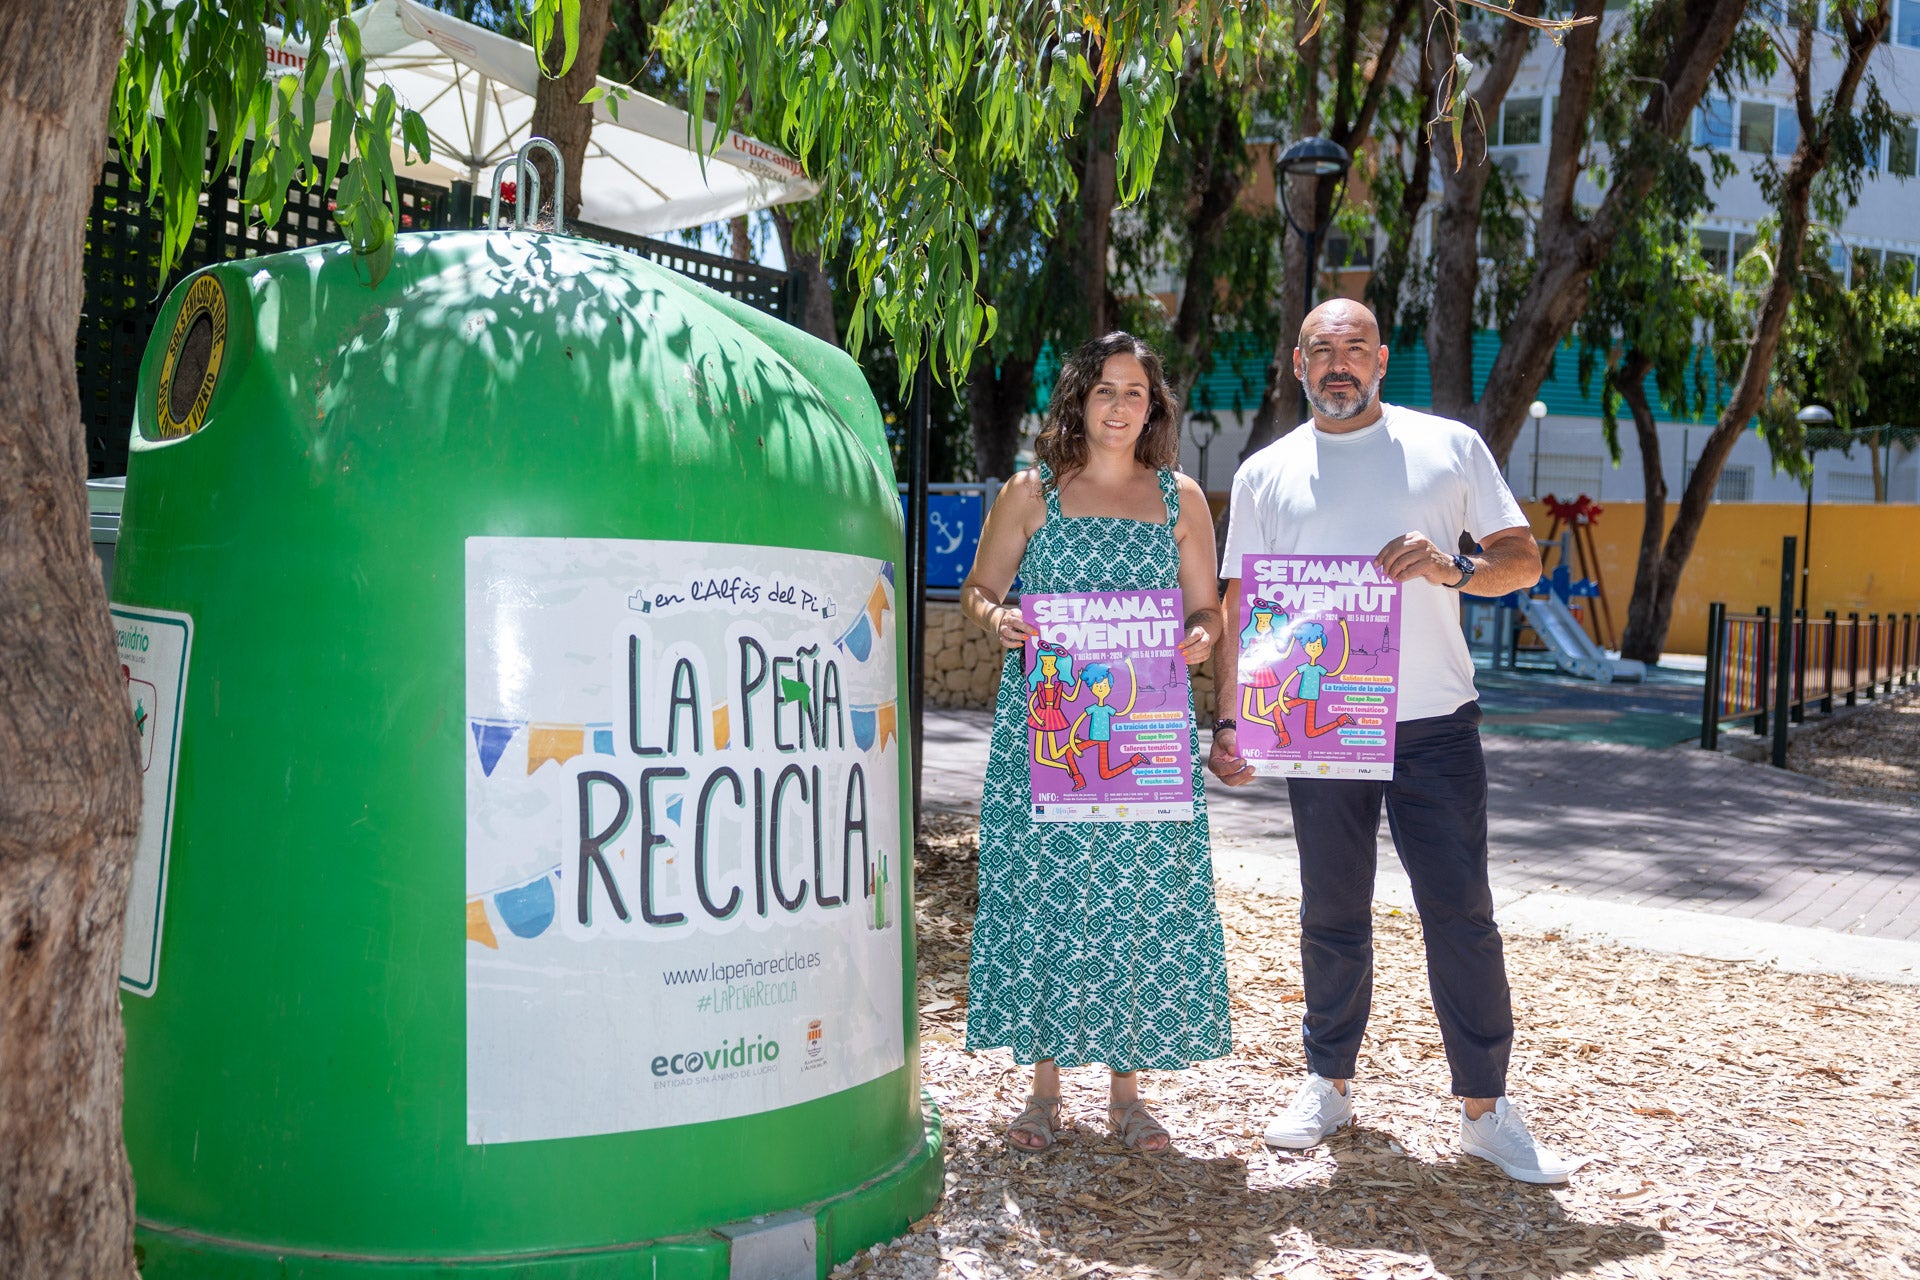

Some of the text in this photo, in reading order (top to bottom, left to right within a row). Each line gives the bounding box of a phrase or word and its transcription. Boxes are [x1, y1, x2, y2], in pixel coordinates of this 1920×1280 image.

[169, 313, 186, 358] SOLS
[192, 373, 215, 428] VIDRIO
[1253, 560, 1380, 585] SETMANA
[655, 576, 818, 612] en l'Alfàs del Pi
[1033, 596, 1174, 623] SETMANA DE LA
[1246, 583, 1397, 613] JOVENTUT
[1031, 620, 1179, 650] JOVENTUT
[628, 633, 846, 758] LA PEÑA
[1242, 749, 1263, 758] INFO:
[1039, 793, 1059, 802] INFO:
[576, 761, 870, 928] RECICLA
[662, 950, 821, 985] www.lapeñarecicla.es
[650, 1034, 780, 1077] ecovidrio
[653, 1078, 693, 1090] ENTIDAD
[695, 1076, 710, 1085] SIN
[740, 1069, 751, 1078] DE
[753, 1064, 778, 1076] LUCRO
